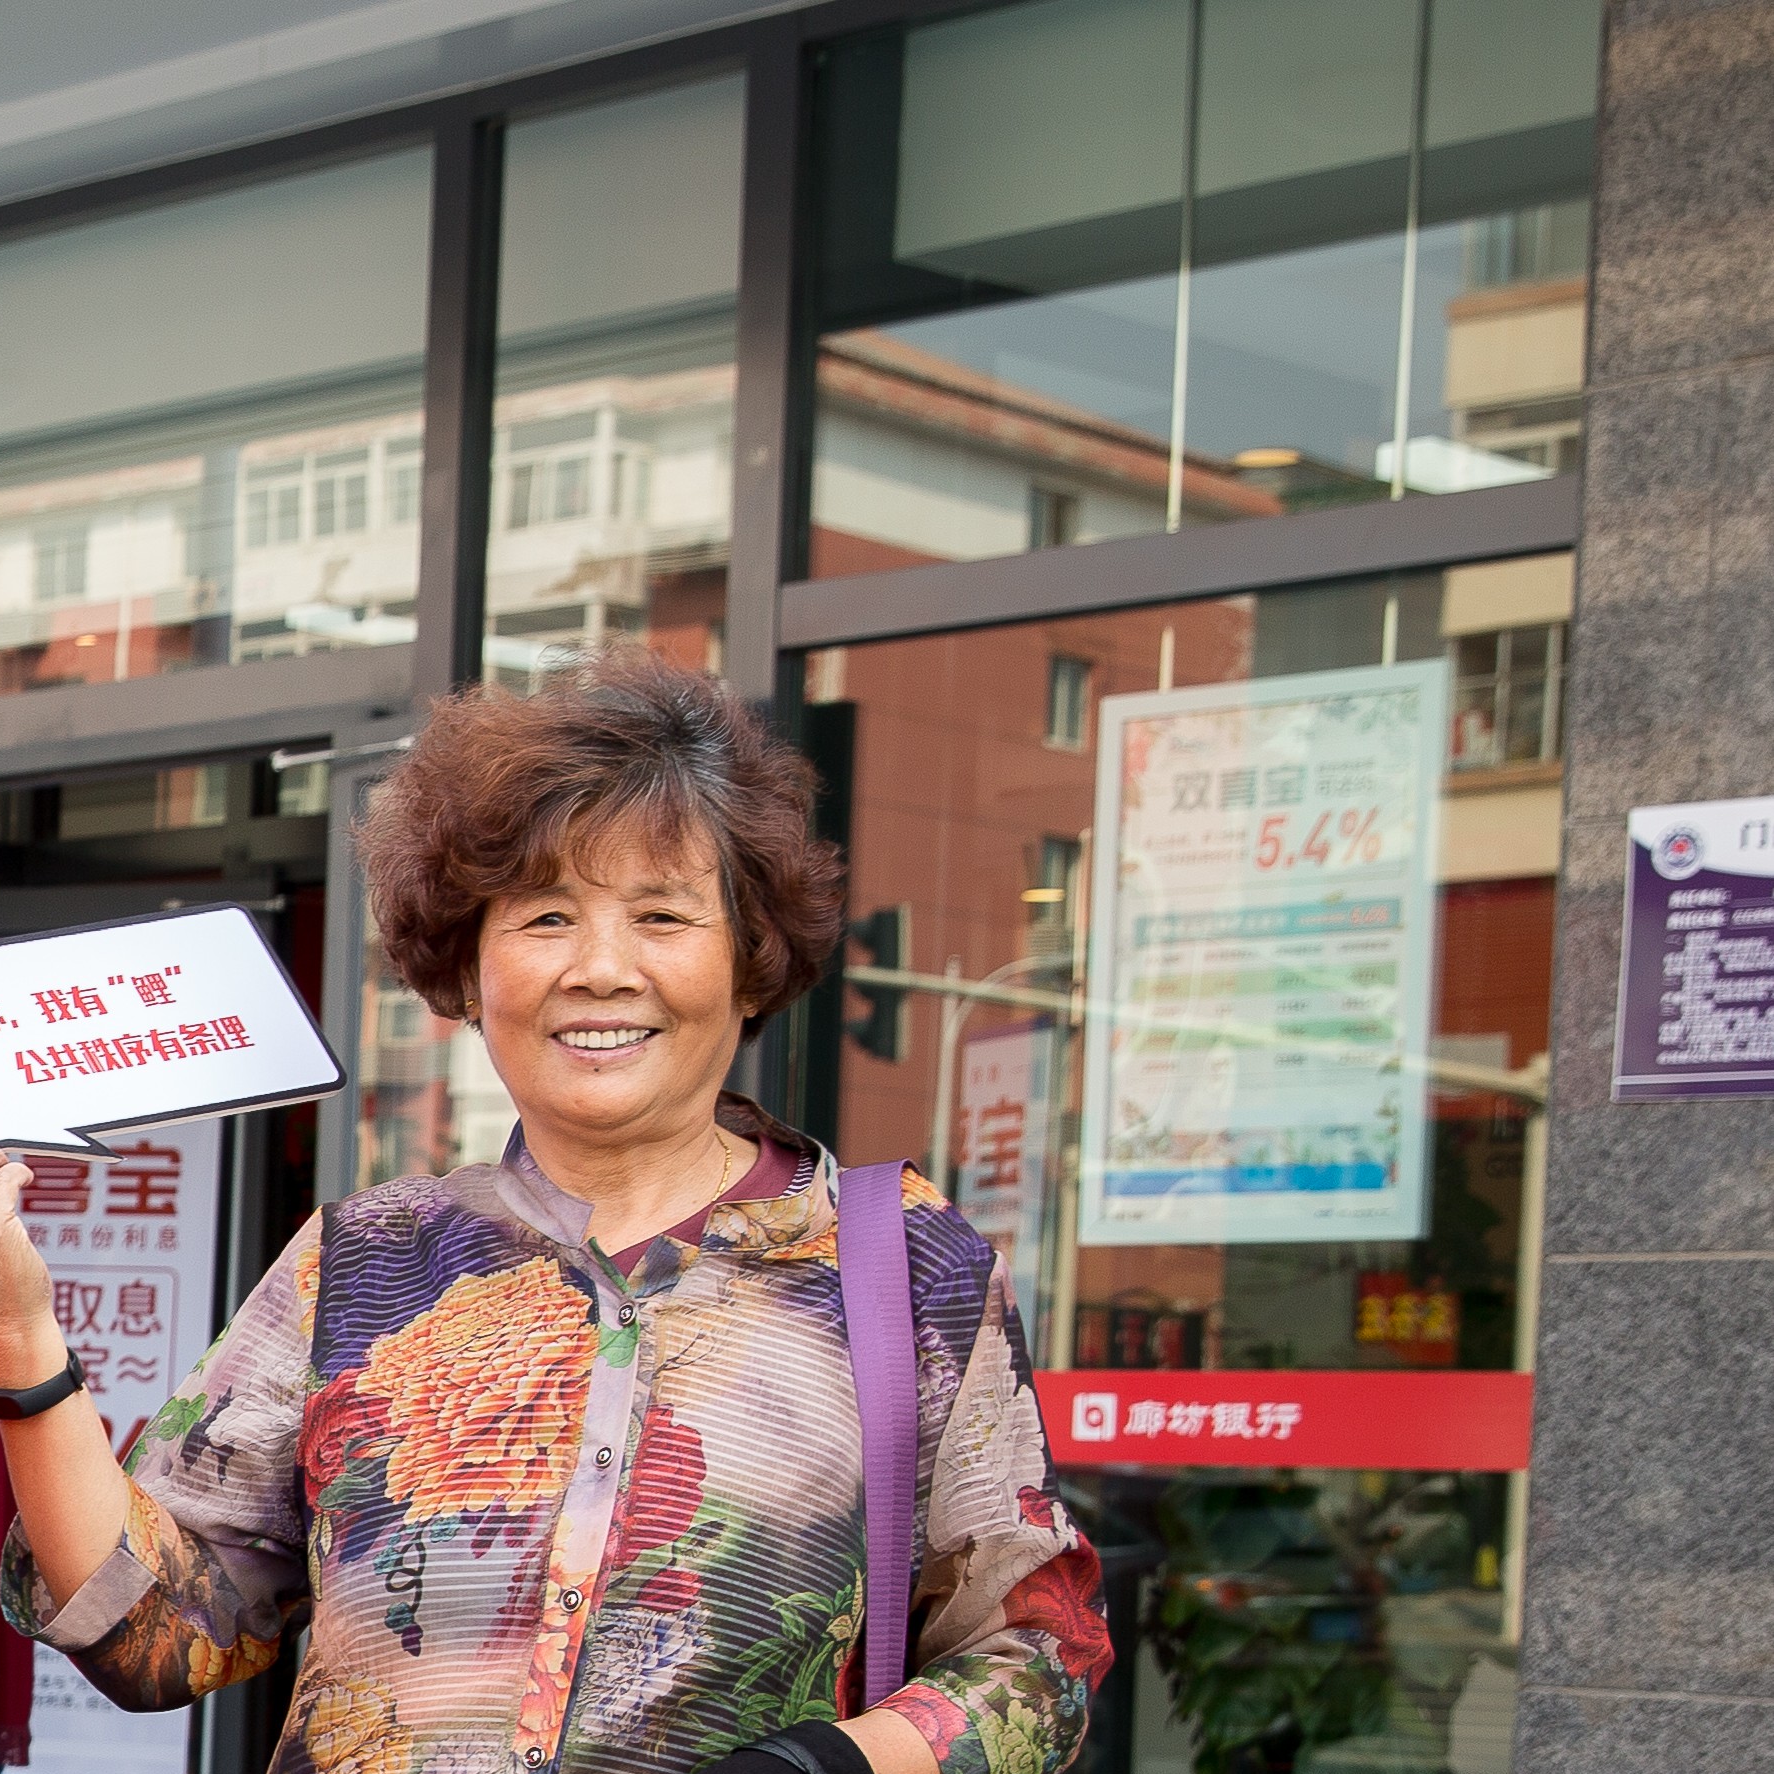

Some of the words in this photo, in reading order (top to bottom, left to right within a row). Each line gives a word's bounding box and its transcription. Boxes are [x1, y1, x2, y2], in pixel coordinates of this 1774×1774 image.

[1255, 805, 1382, 871] 5.4%
[15, 1015, 255, 1084] 公共秩序有条理
[52, 1278, 162, 1337] 取息
[1123, 1399, 1302, 1440] 廊坊银行
